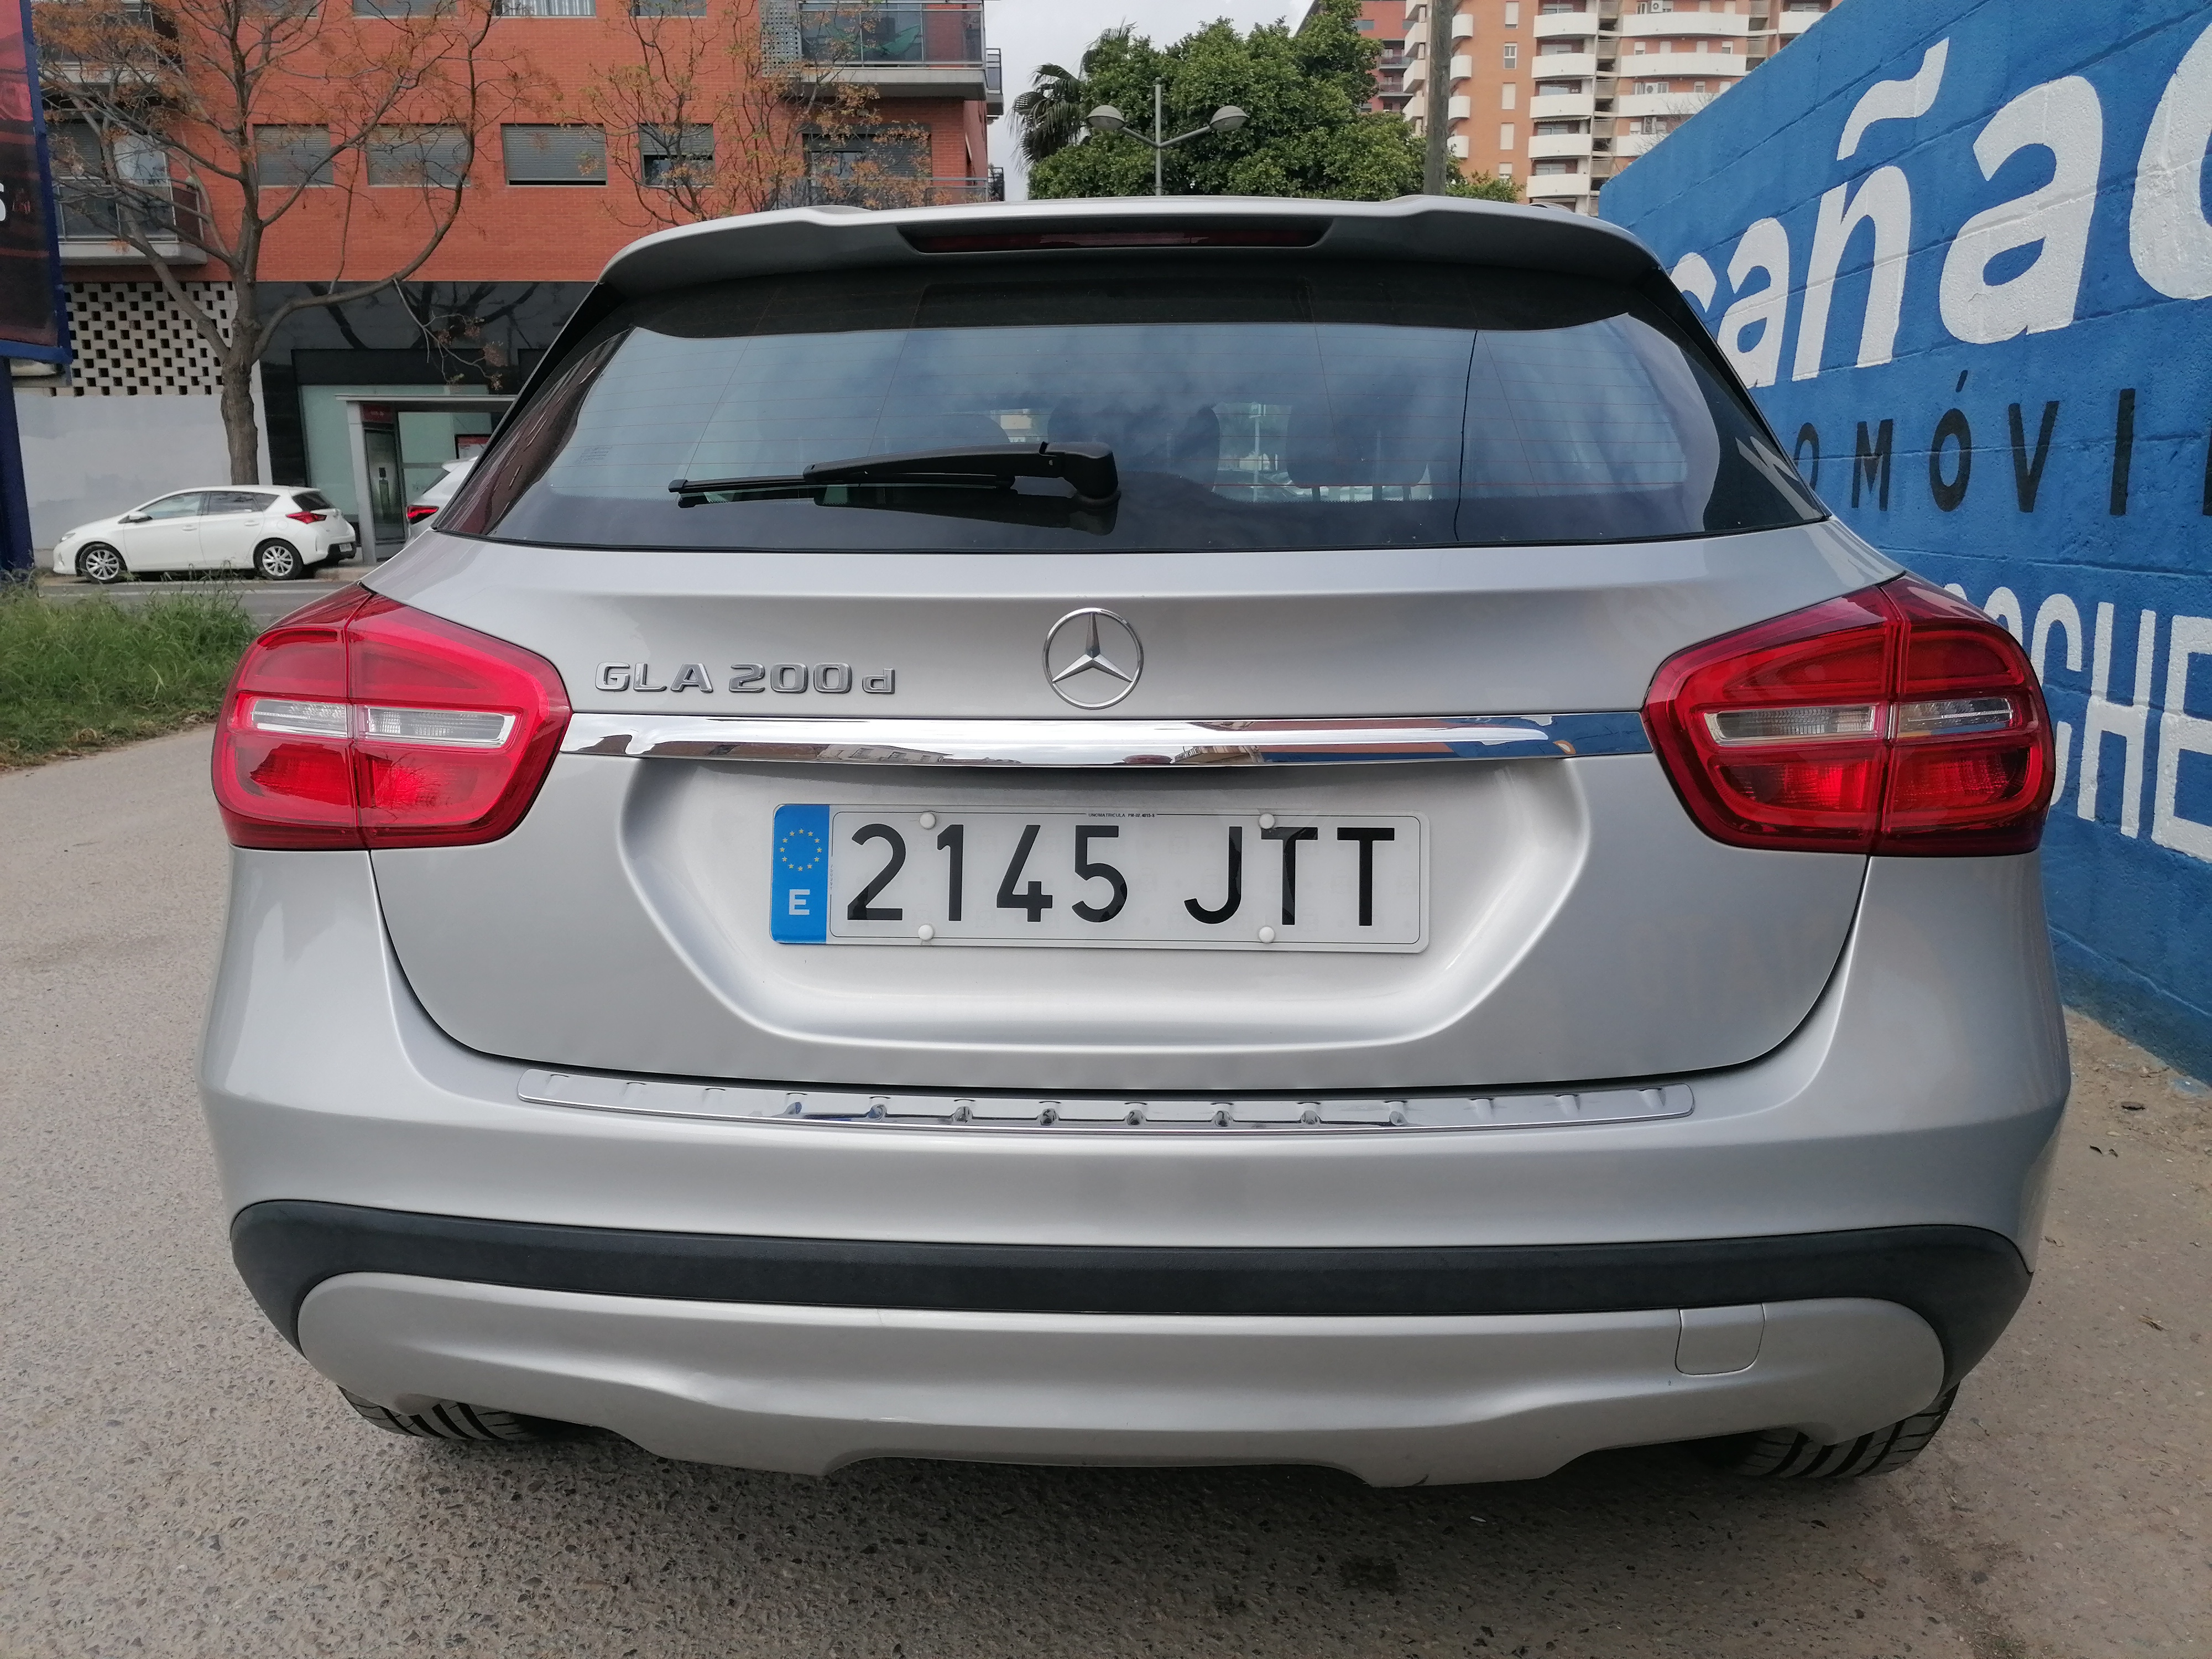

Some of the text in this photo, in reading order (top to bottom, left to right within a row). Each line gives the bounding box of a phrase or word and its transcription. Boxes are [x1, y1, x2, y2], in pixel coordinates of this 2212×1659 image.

[1793, 370, 2212, 515] OMÓVI
[595, 662, 895, 694] GLA 200 d
[789, 889, 810, 915] E
[847, 823, 1395, 926] 2145 JTT
